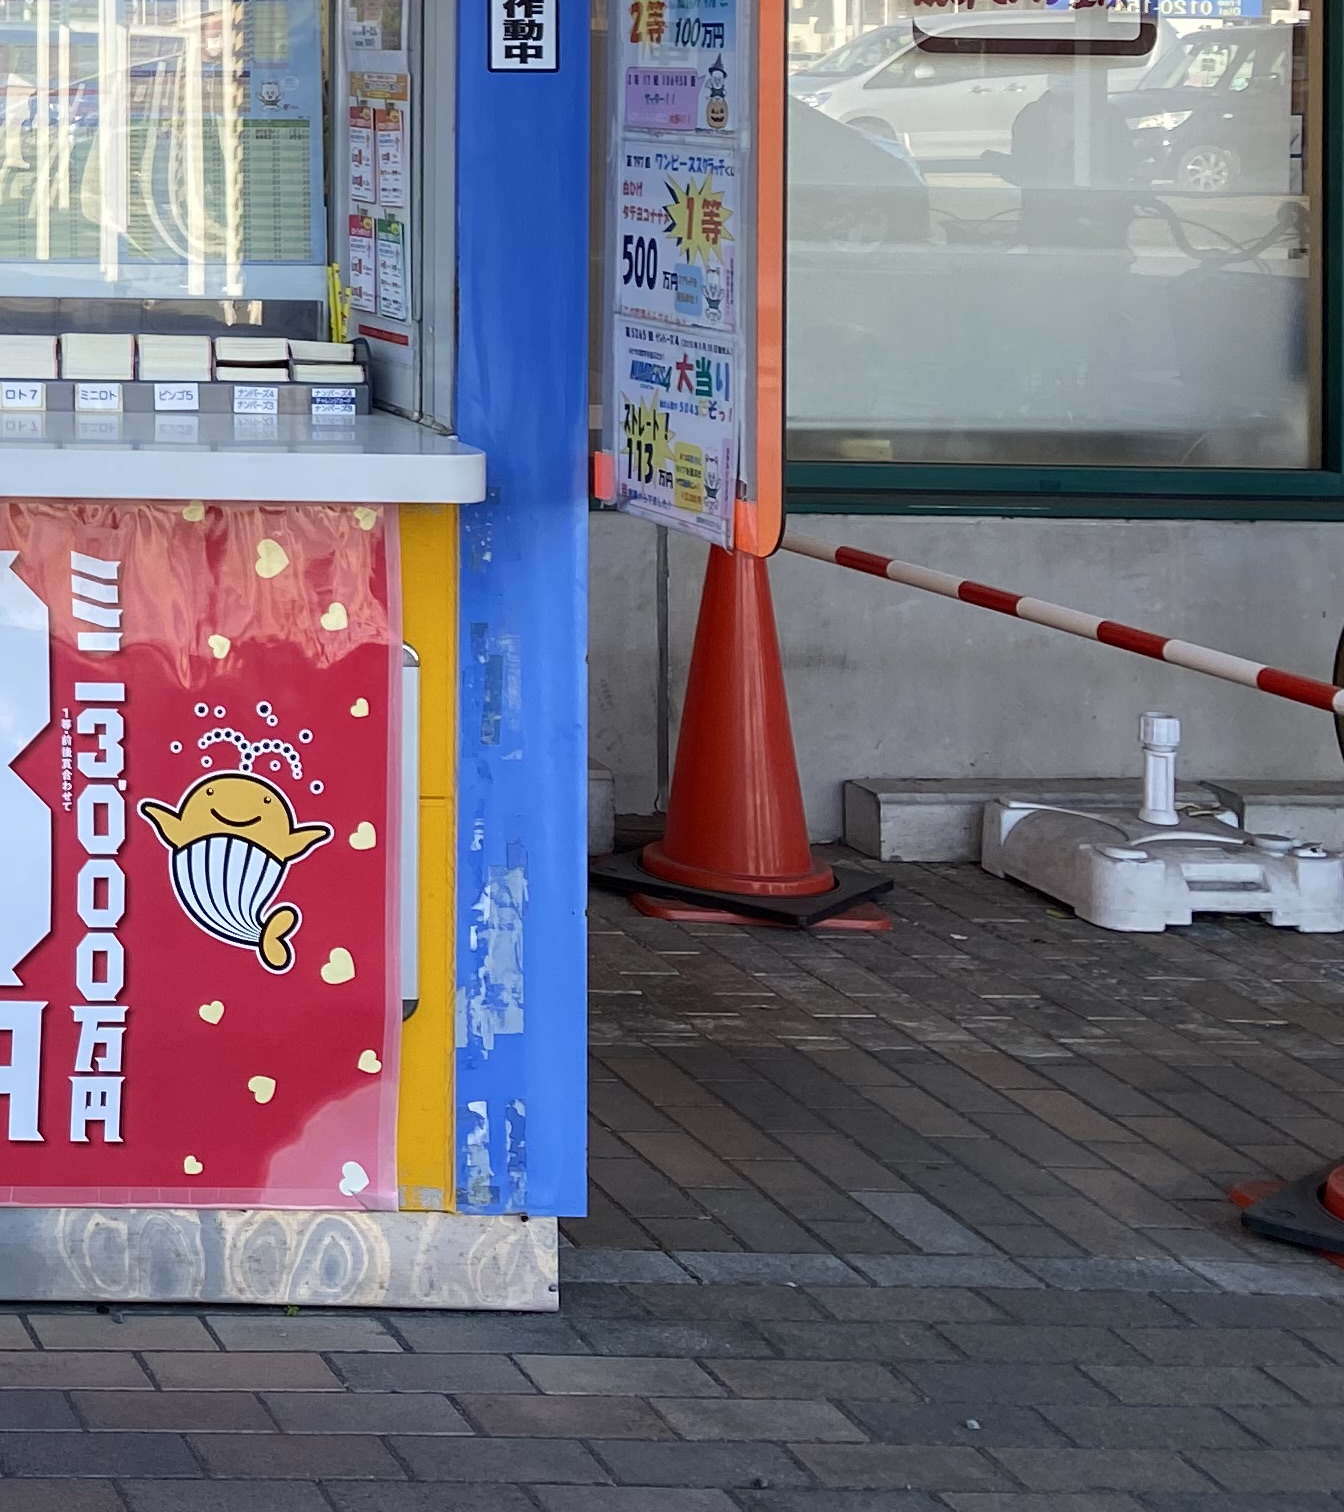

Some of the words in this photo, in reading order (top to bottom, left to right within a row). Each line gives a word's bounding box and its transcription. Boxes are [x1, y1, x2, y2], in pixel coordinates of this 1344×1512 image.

[629, 1, 667, 43] 2等
[675, 17, 725, 49] 100万円
[686, 196, 723, 245] 1等
[623, 235, 658, 290] 500
[663, 270, 678, 291] 万円
[676, 353, 729, 401] 大当り
[6, 389, 38, 400] ロト7
[80, 390, 117, 400] ミニロト
[159, 390, 194, 401] ビンゴ5
[238, 389, 275, 398] ナンバーズ4
[237, 401, 274, 410] ナンバーズ3
[314, 405, 353, 413] ナンバーズ3
[627, 437, 653, 484] 113
[659, 469, 674, 489] 万円
[60, 707, 73, 812] 1等・前後賞合わせて
